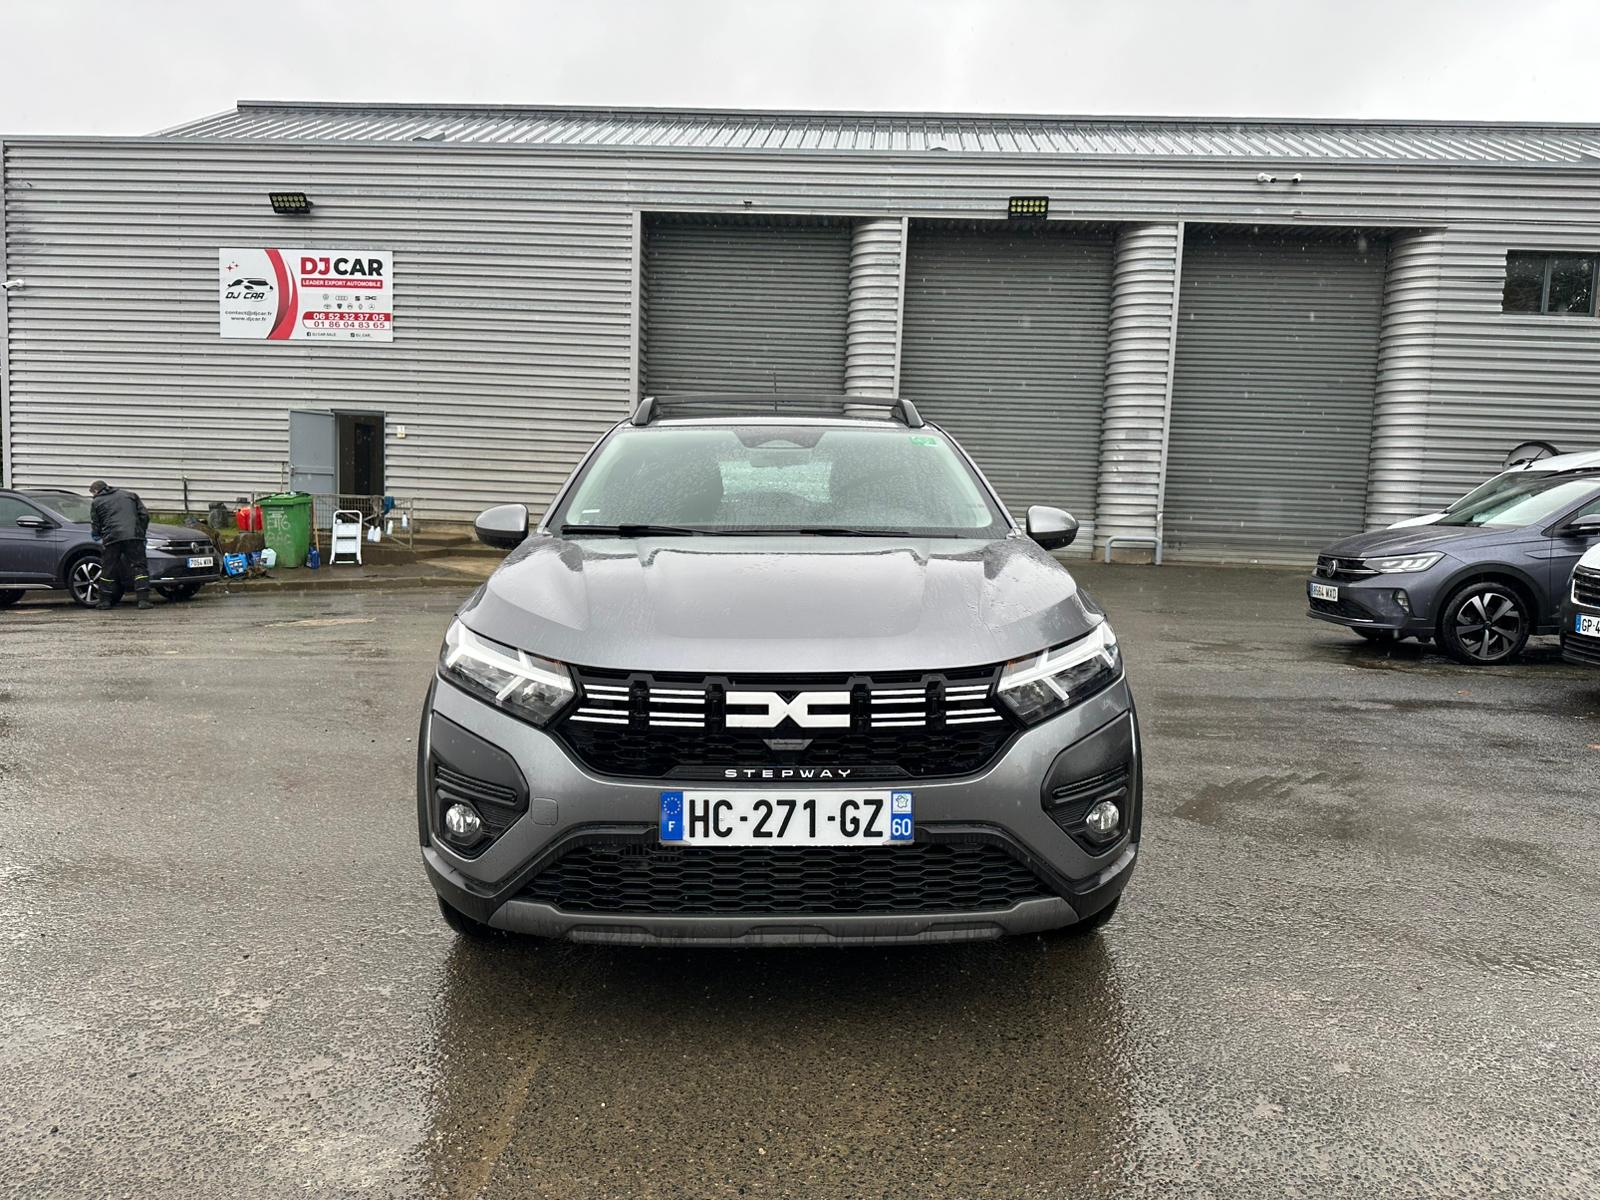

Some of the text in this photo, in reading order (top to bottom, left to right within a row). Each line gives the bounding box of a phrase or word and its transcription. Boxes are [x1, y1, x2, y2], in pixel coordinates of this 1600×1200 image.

[301, 257, 383, 276] DJ CAR
[724, 769, 851, 778] STEPWAY
[667, 821, 676, 832] F
[688, 799, 884, 838] HC-271-GZ
[892, 818, 912, 836] 60
